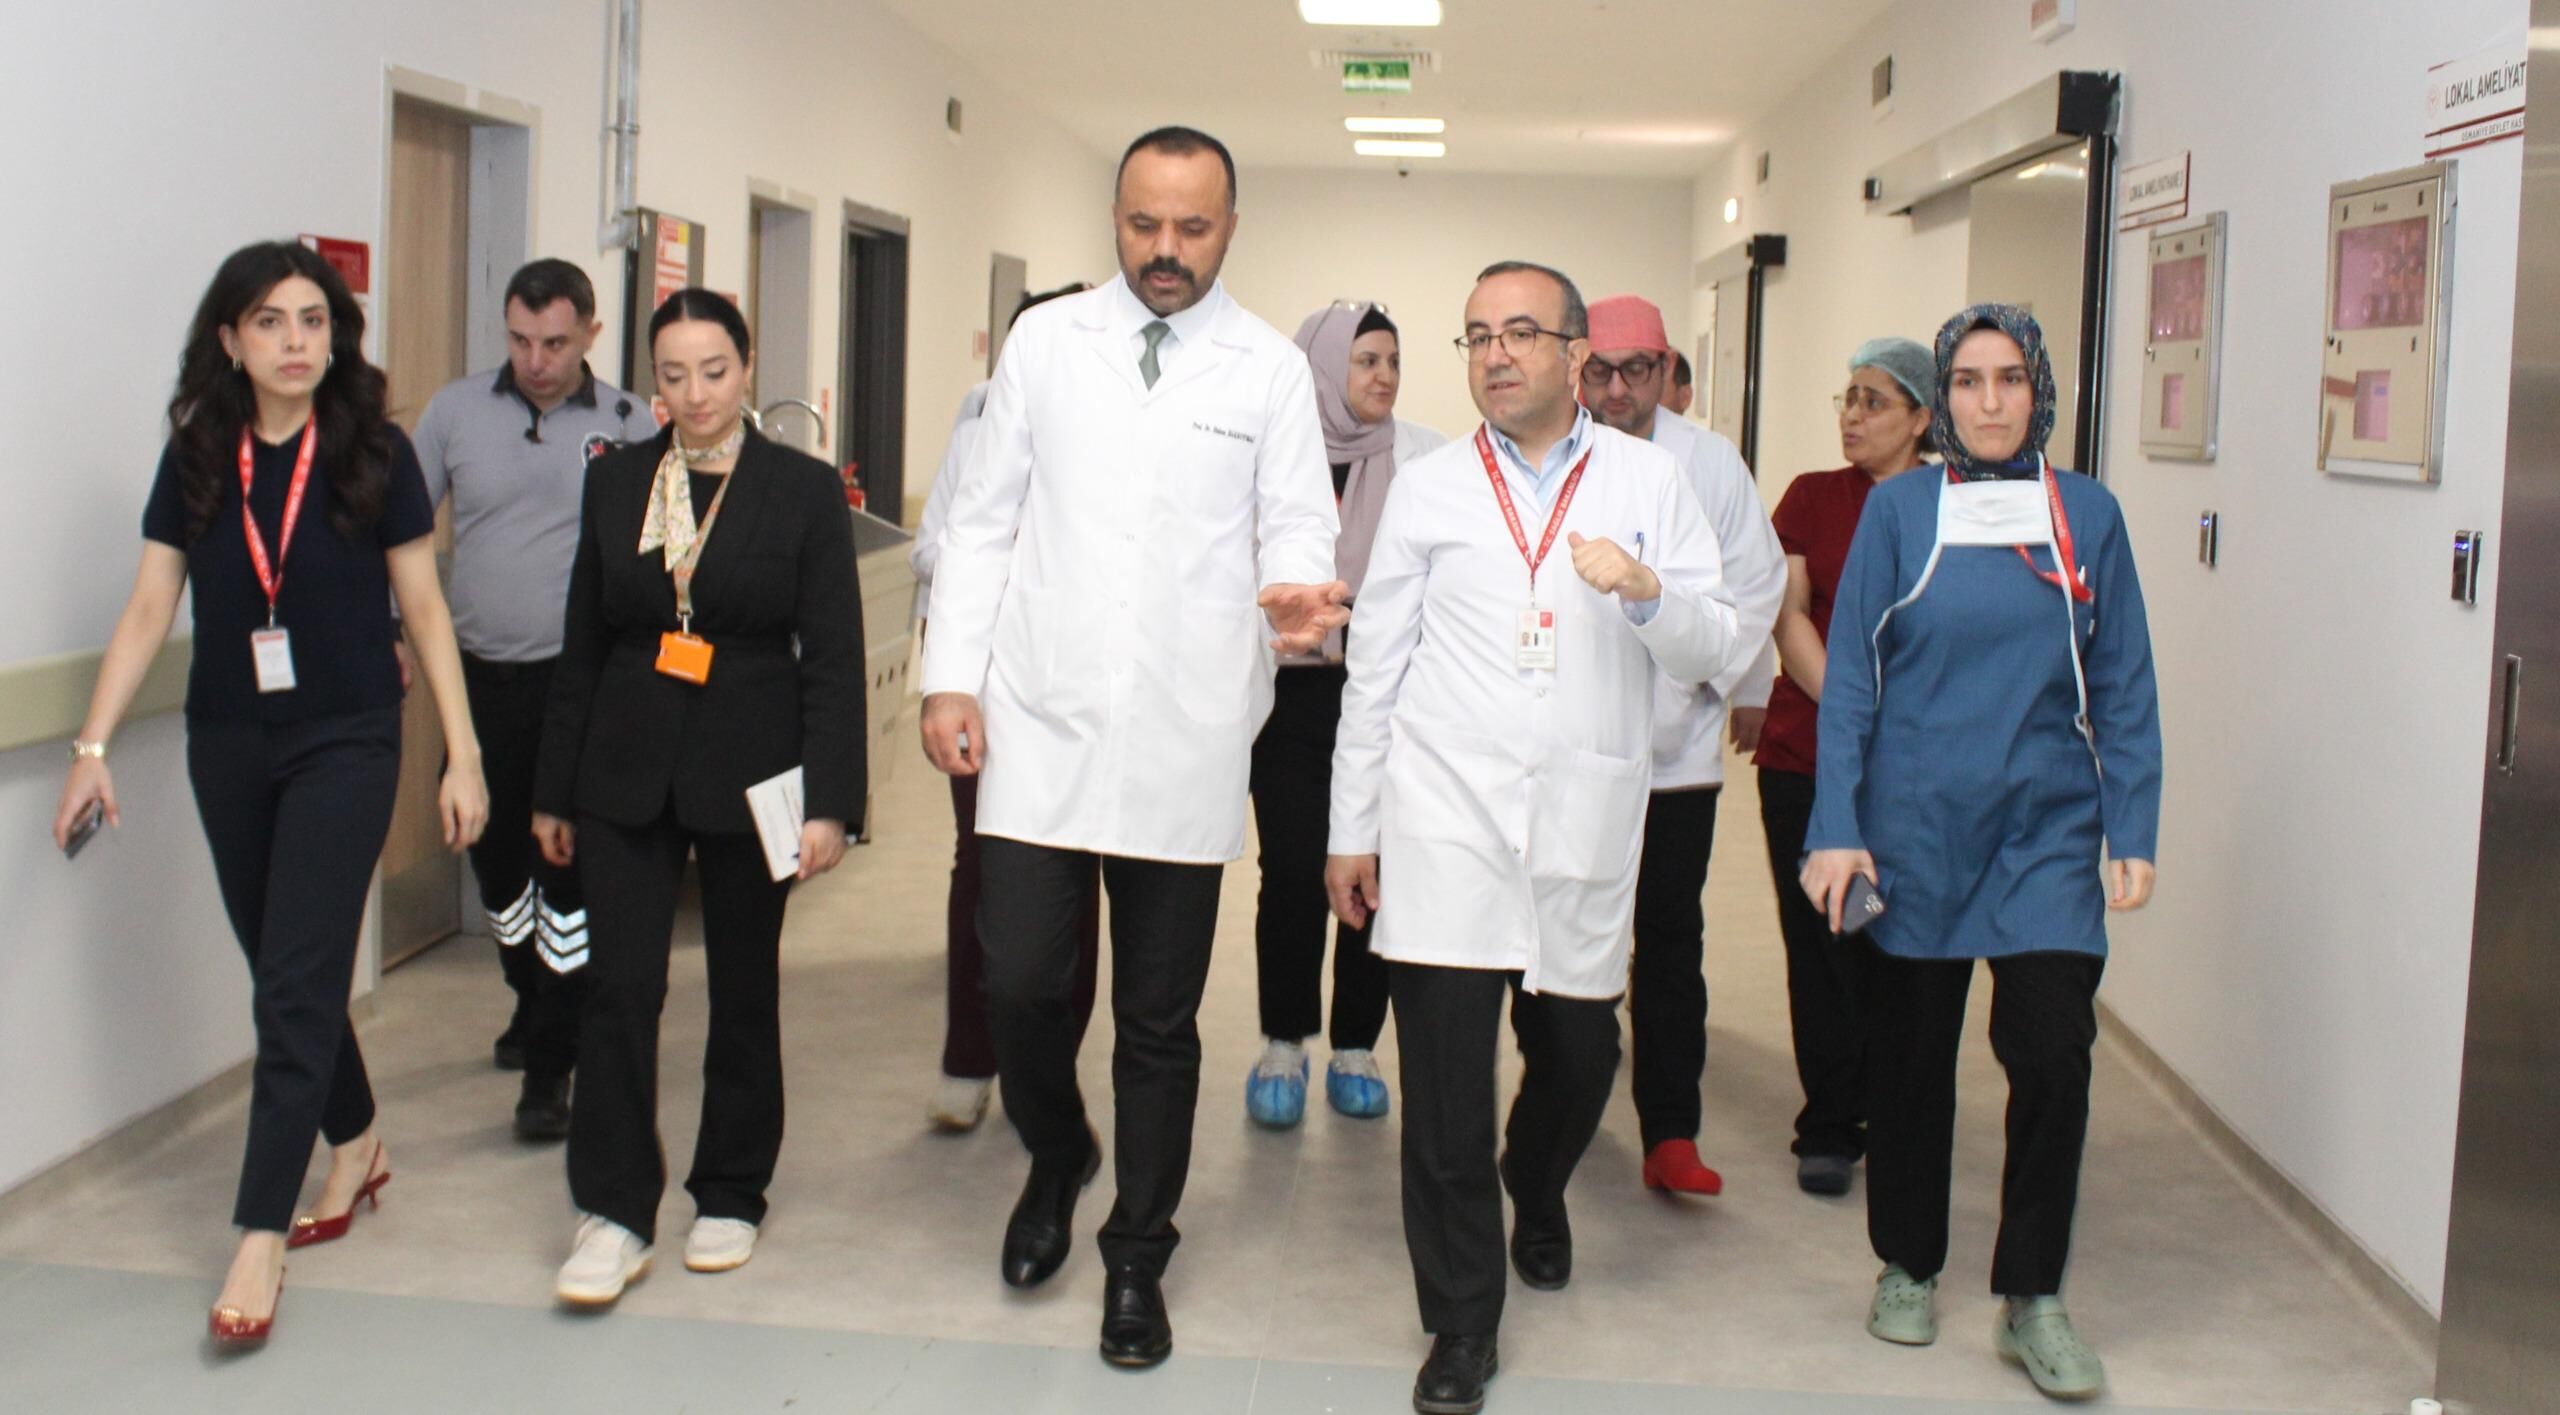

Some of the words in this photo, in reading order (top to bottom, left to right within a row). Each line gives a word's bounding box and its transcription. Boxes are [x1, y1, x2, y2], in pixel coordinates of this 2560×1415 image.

[2445, 78, 2475, 109] LOKAL
[2476, 60, 2526, 99] AMELİYAT
[2489, 120, 2509, 135] DEVLET
